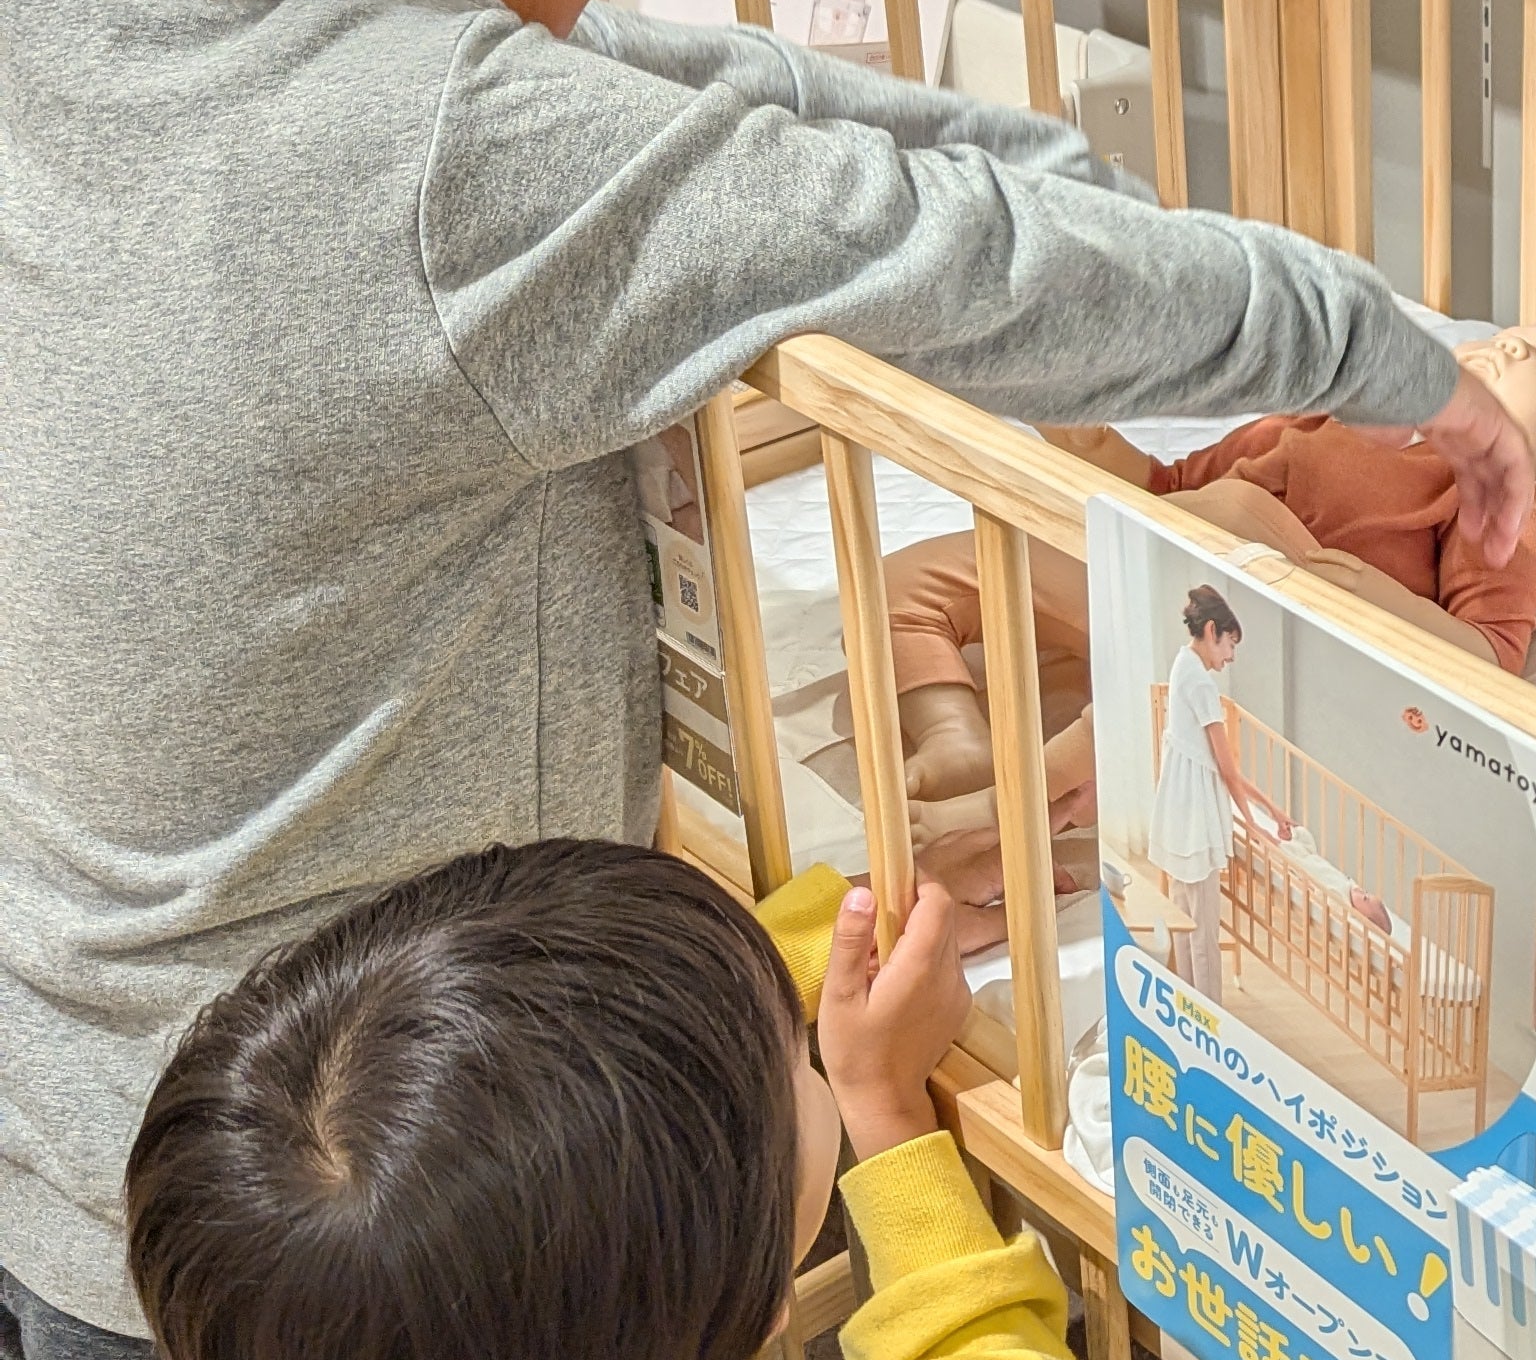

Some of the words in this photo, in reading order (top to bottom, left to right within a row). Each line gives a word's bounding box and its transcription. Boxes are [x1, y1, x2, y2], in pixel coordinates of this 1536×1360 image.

[697, 759, 733, 798] OFF!
[1182, 997, 1211, 1031] Max
[1132, 959, 1448, 1221] 75cmのハイポジション
[1122, 1034, 1448, 1322] 腰に優しい!
[1143, 1158, 1219, 1226] 側面も足元も
[1147, 1178, 1215, 1242] 開閉できる
